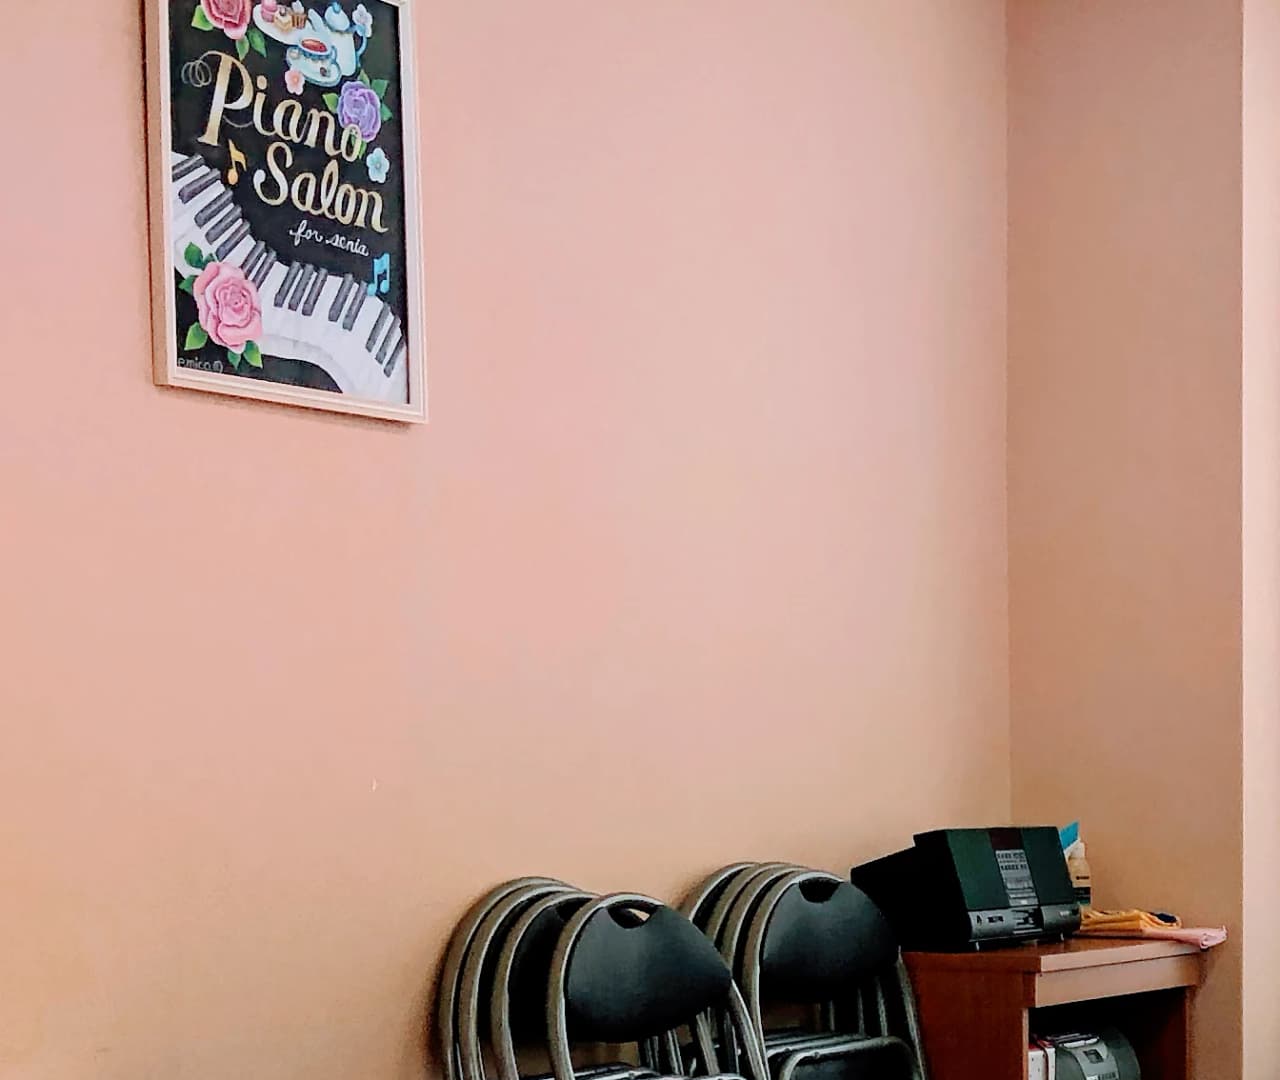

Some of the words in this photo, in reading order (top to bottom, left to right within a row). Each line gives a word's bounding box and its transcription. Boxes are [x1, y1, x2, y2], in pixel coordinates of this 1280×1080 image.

[182, 51, 363, 162] Piano
[253, 141, 389, 233] Salon
[289, 219, 323, 246] for
